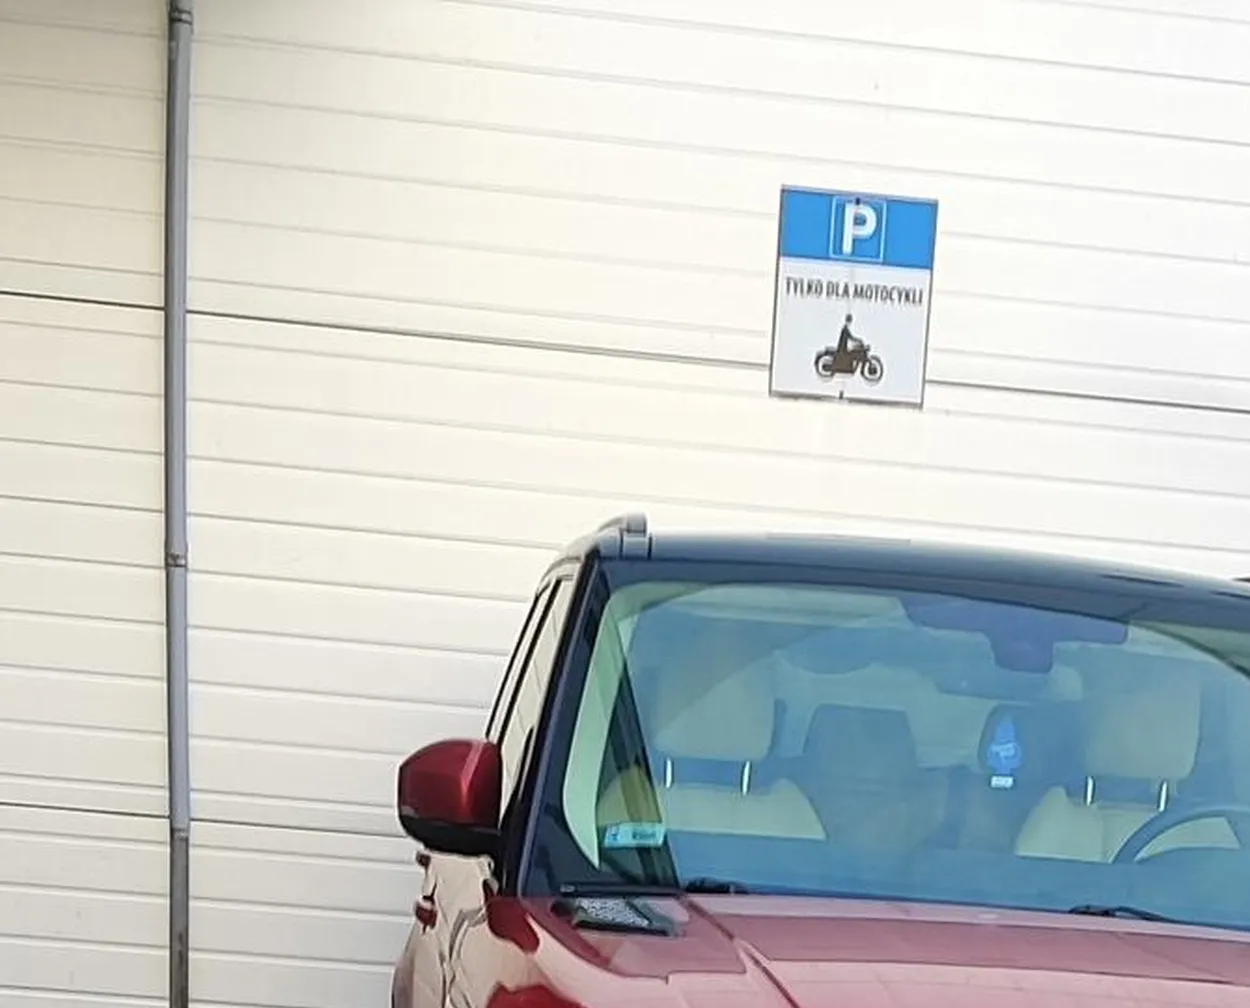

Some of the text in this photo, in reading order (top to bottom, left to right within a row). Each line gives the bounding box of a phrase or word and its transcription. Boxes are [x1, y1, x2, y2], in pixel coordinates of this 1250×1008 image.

[842, 201, 877, 256] P
[785, 277, 923, 305] TYLKO DLA MOTOCYKLI
